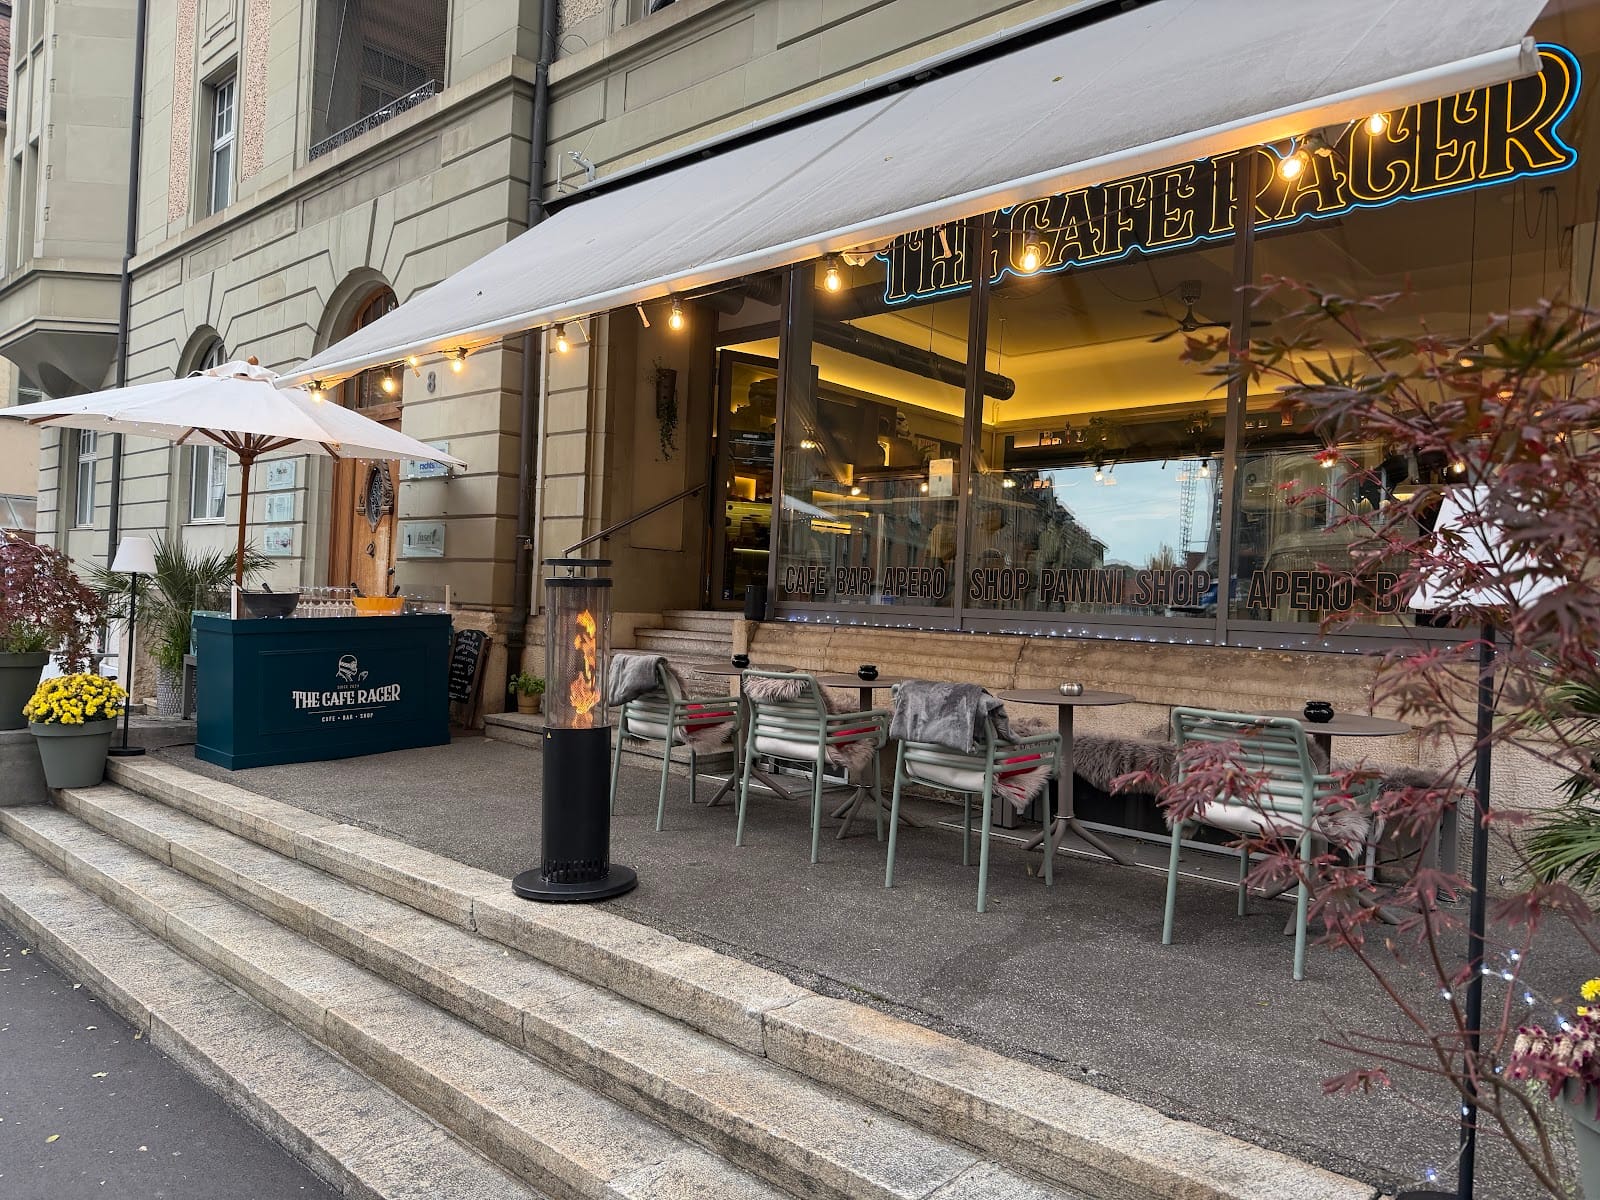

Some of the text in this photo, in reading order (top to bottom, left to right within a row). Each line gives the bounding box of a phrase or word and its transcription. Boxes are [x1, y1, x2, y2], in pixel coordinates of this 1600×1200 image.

[1009, 164, 1195, 272] CAFE
[426, 371, 436, 393] 8
[784, 565, 946, 599] CAFE BAR APERO
[969, 567, 1211, 607] SHOP PANINI SHOP
[1246, 570, 1354, 612] APERO
[292, 683, 401, 709] THE CAFE RACER
[321, 715, 336, 723] CAFE
